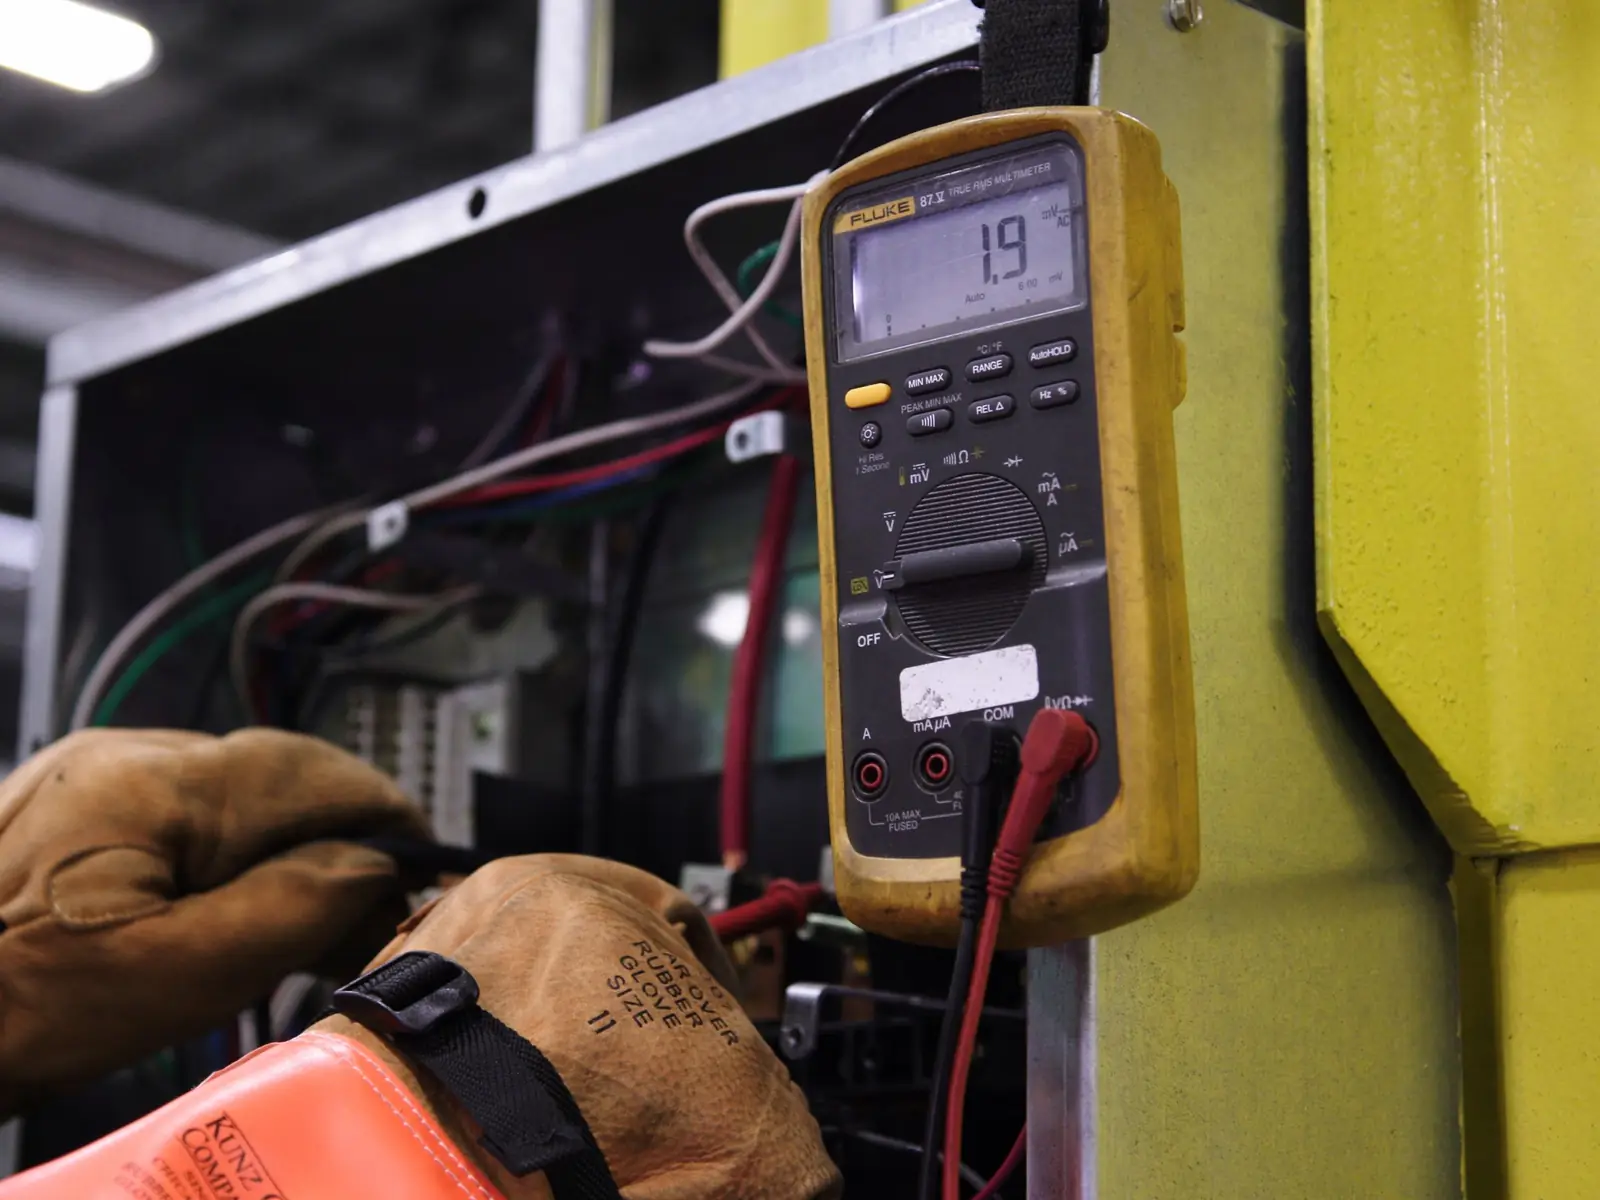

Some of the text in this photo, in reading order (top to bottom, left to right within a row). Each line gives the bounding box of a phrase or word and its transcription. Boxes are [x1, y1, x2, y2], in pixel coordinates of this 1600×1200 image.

[850, 200, 911, 227] FLUKE
[948, 184, 971, 197] TRUE
[973, 177, 993, 190] RMS
[994, 162, 1051, 185] MULTIMETER
[1057, 214, 1070, 229] AC
[981, 214, 1027, 286] 1.9
[965, 292, 985, 304] Auto
[1030, 344, 1071, 361] AutoHOLD
[972, 360, 1003, 374] RANGE
[908, 373, 944, 389] MIN MAX
[1039, 390, 1051, 400] Hz
[901, 393, 962, 414] PEAK MIN MAX
[976, 405, 993, 415] REL
[868, 452, 884, 462] Res
[861, 461, 890, 474] Second
[910, 468, 930, 484] mV
[1038, 475, 1061, 493] mA
[857, 632, 881, 648] OFF
[983, 706, 1014, 722] COM
[862, 727, 872, 740] A
[885, 809, 921, 823] 10A MAX
[888, 820, 919, 832] FUSED
[619, 955, 682, 1029] GLOVE
[632, 939, 704, 1029] RUBBER
[607, 974, 654, 1028] SIZE
[587, 1009, 617, 1035] 11
[689, 985, 740, 1046] OVER
